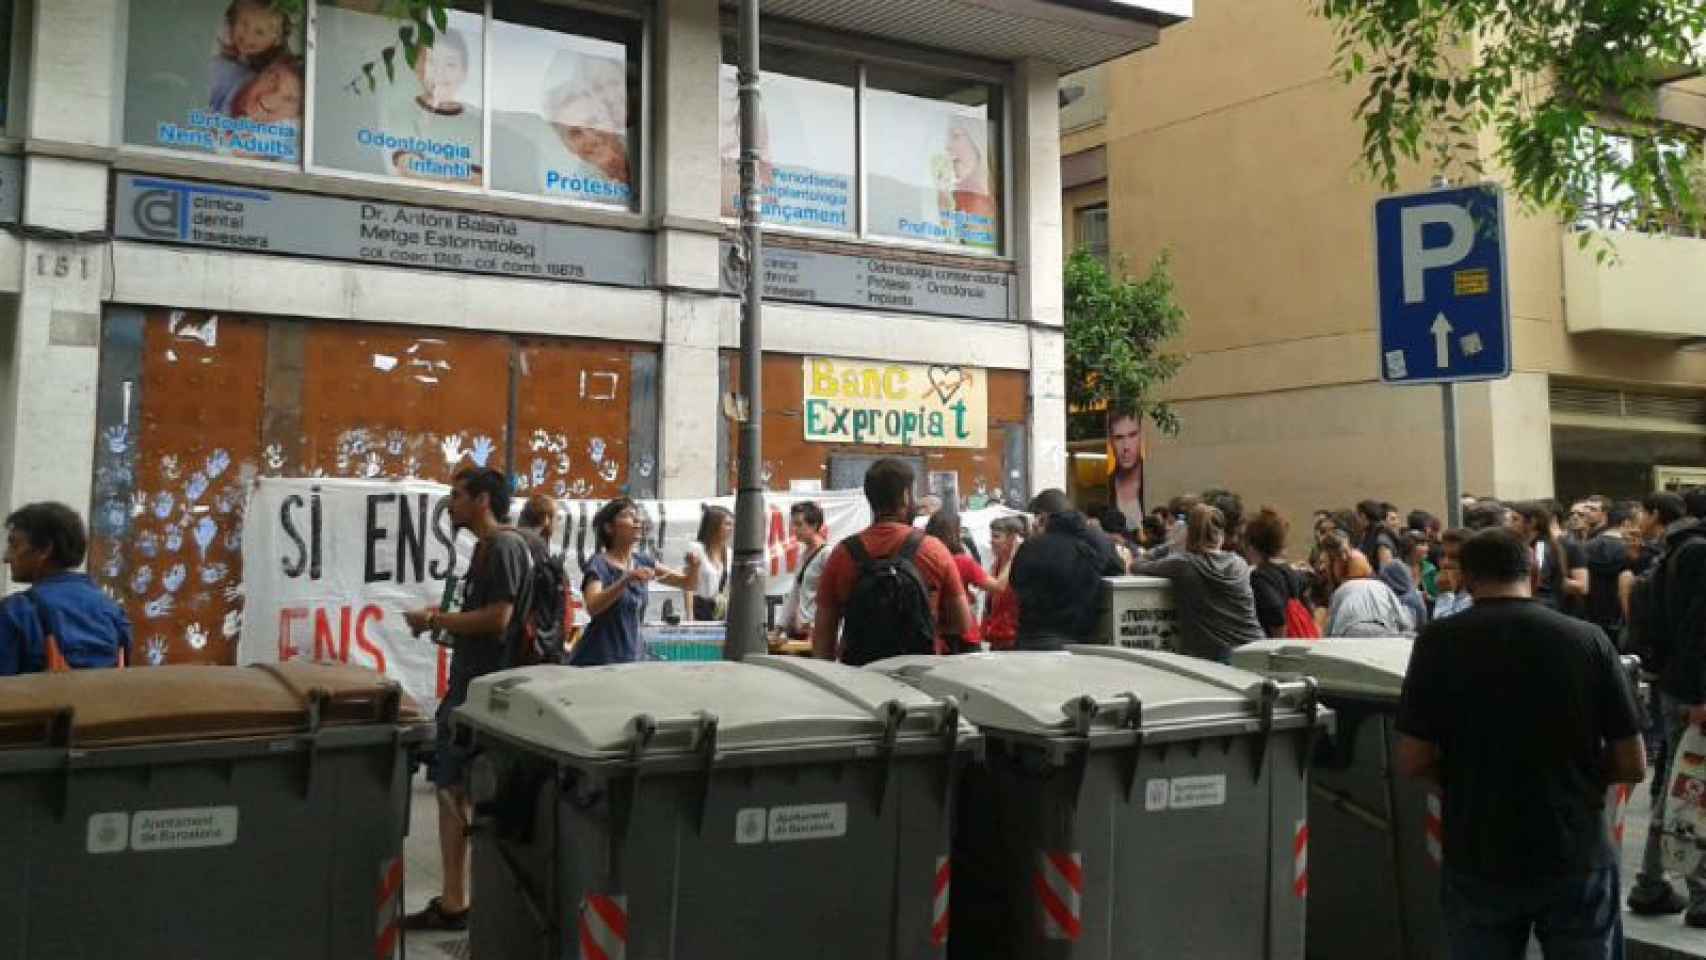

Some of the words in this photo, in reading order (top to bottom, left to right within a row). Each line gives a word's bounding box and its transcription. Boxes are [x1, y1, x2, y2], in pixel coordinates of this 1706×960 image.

[357, 128, 472, 159] Odontologia
[408, 156, 471, 178] Infantil
[192, 211, 244, 230] dental
[360, 204, 388, 222] Dr.
[393, 206, 450, 229] Antoni
[360, 224, 420, 247] Metge
[1401, 204, 1475, 303] P
[806, 399, 971, 443] Expropiat
